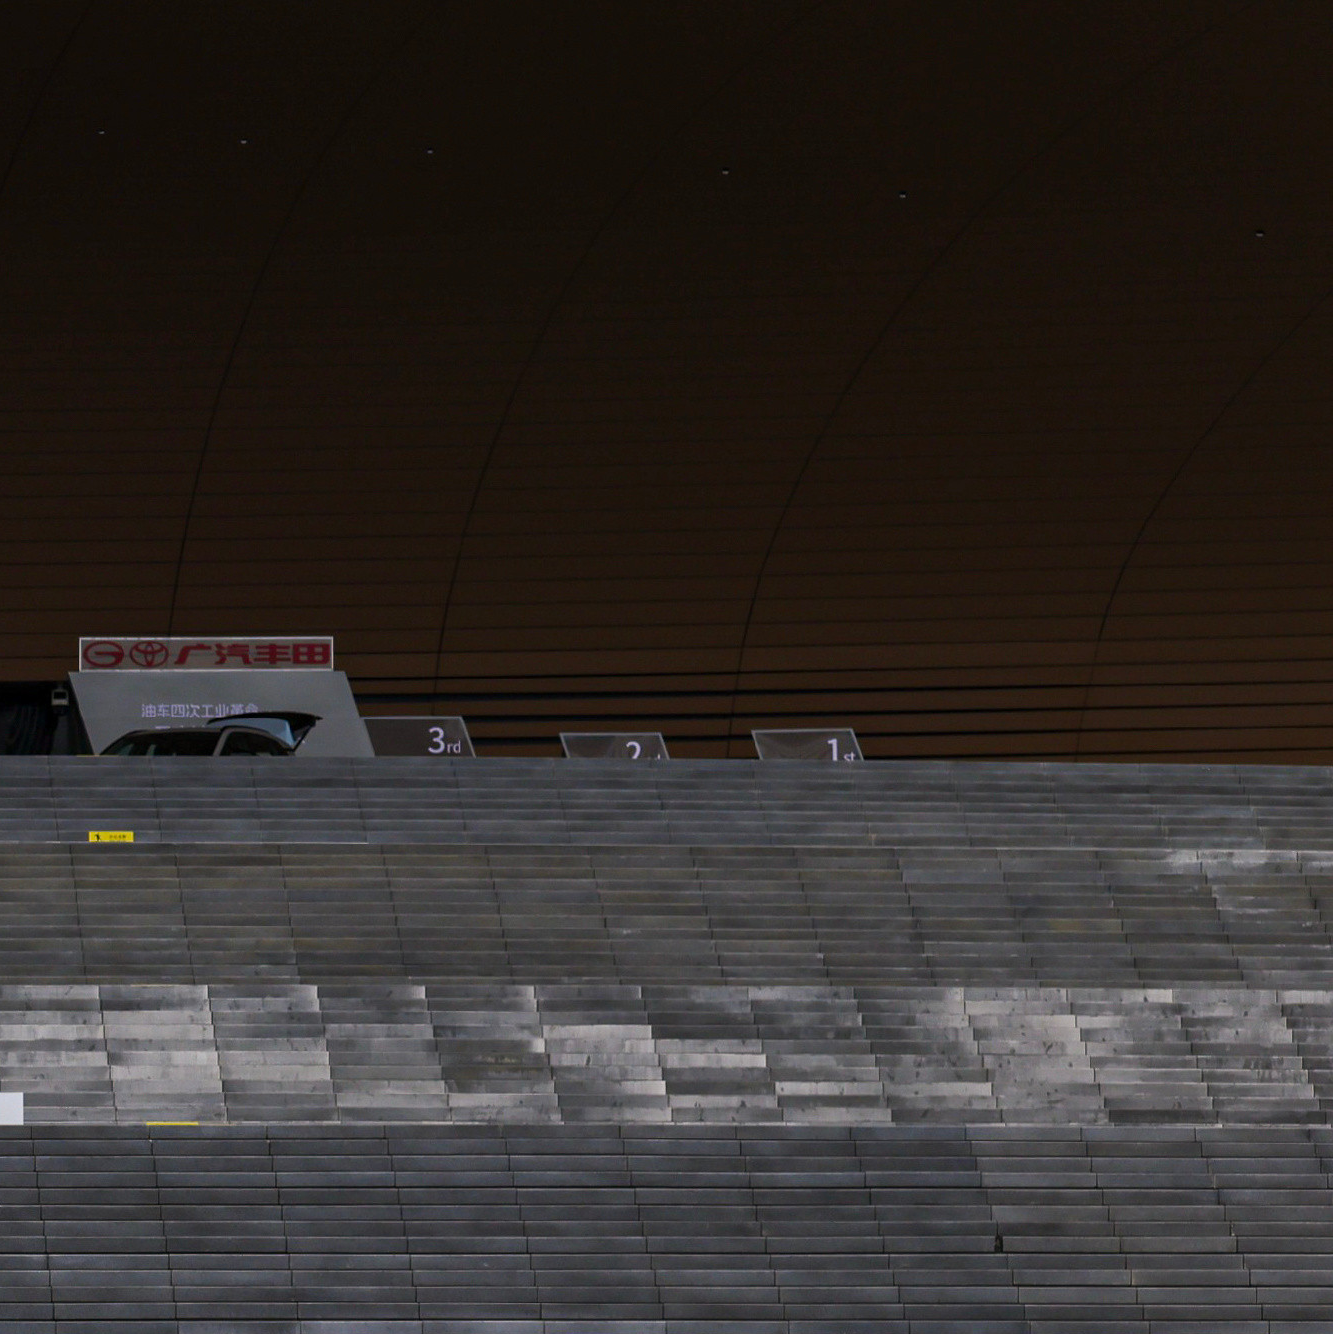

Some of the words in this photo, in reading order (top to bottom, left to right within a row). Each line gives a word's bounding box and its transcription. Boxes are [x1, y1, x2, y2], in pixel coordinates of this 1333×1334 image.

[174, 643, 330, 665] 广汽丰田
[428, 727, 461, 754] 3rd
